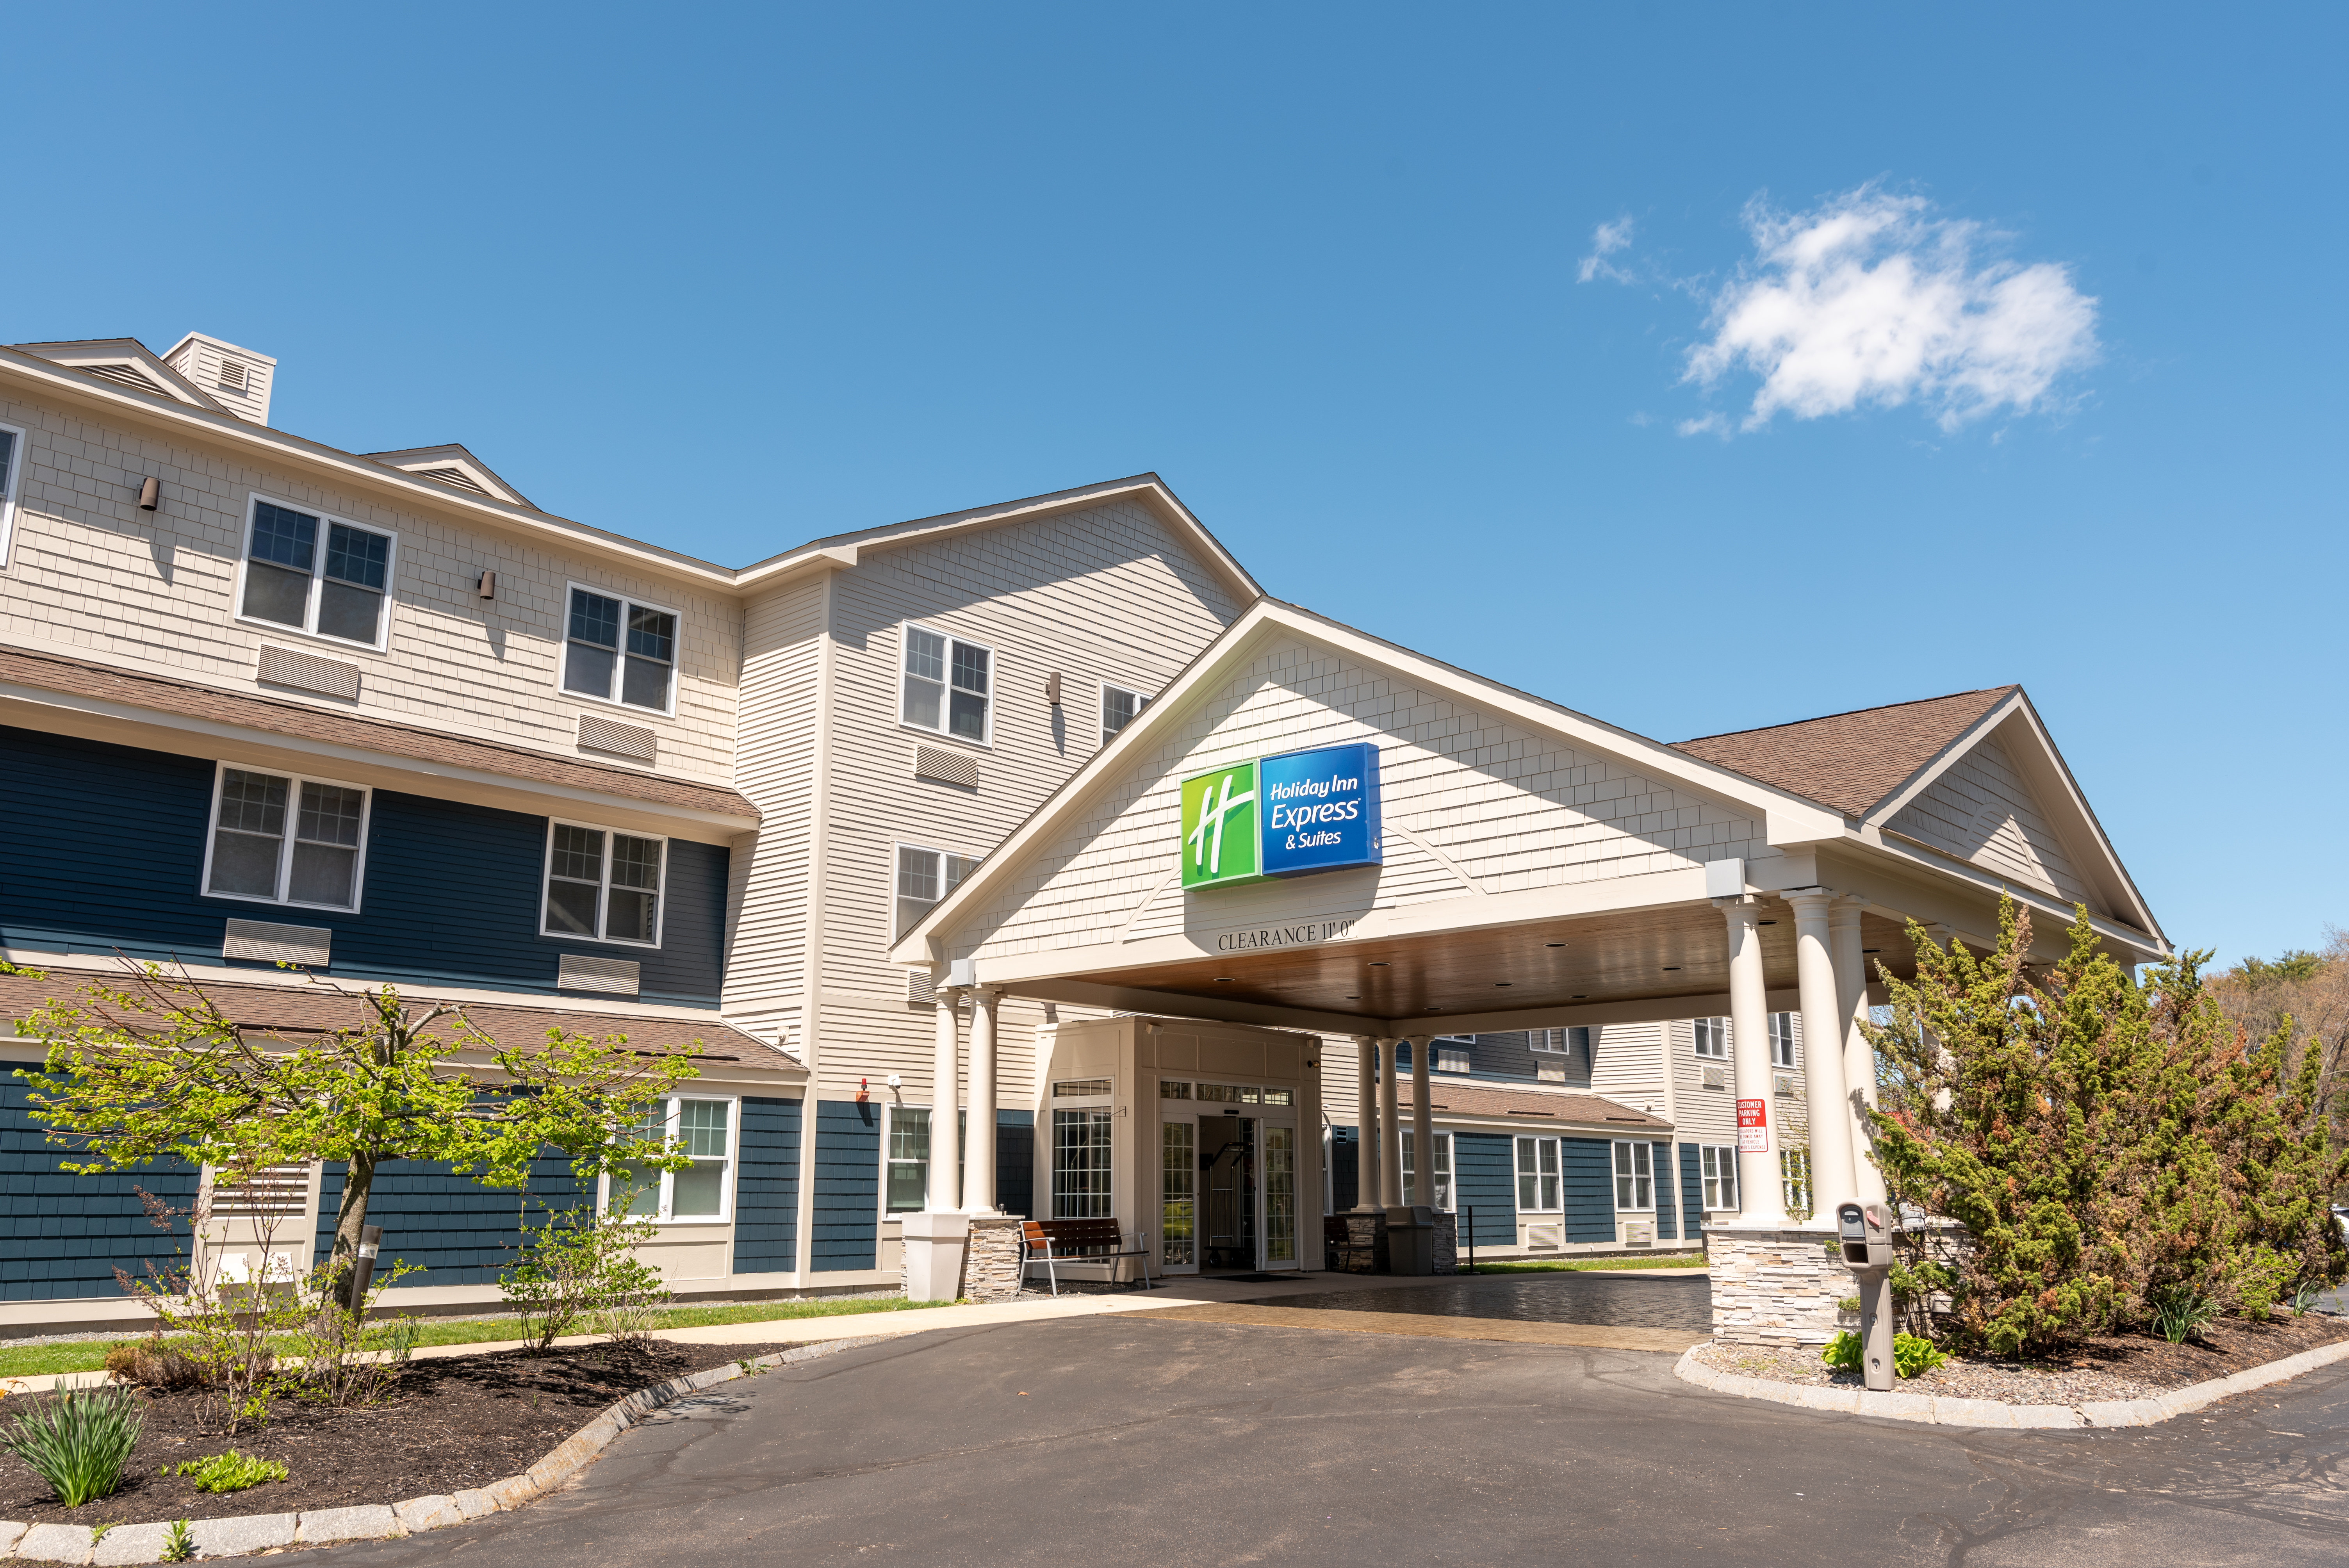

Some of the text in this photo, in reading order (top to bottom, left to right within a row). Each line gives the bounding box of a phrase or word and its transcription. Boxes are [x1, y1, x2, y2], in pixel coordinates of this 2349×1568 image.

[1270, 775, 1358, 801] Holiday Inn
[1271, 800, 1358, 832] Express
[1285, 830, 1341, 850] & Suites
[1218, 925, 1316, 950] CLEARANCE
[1322, 922, 1335, 939] 11'
